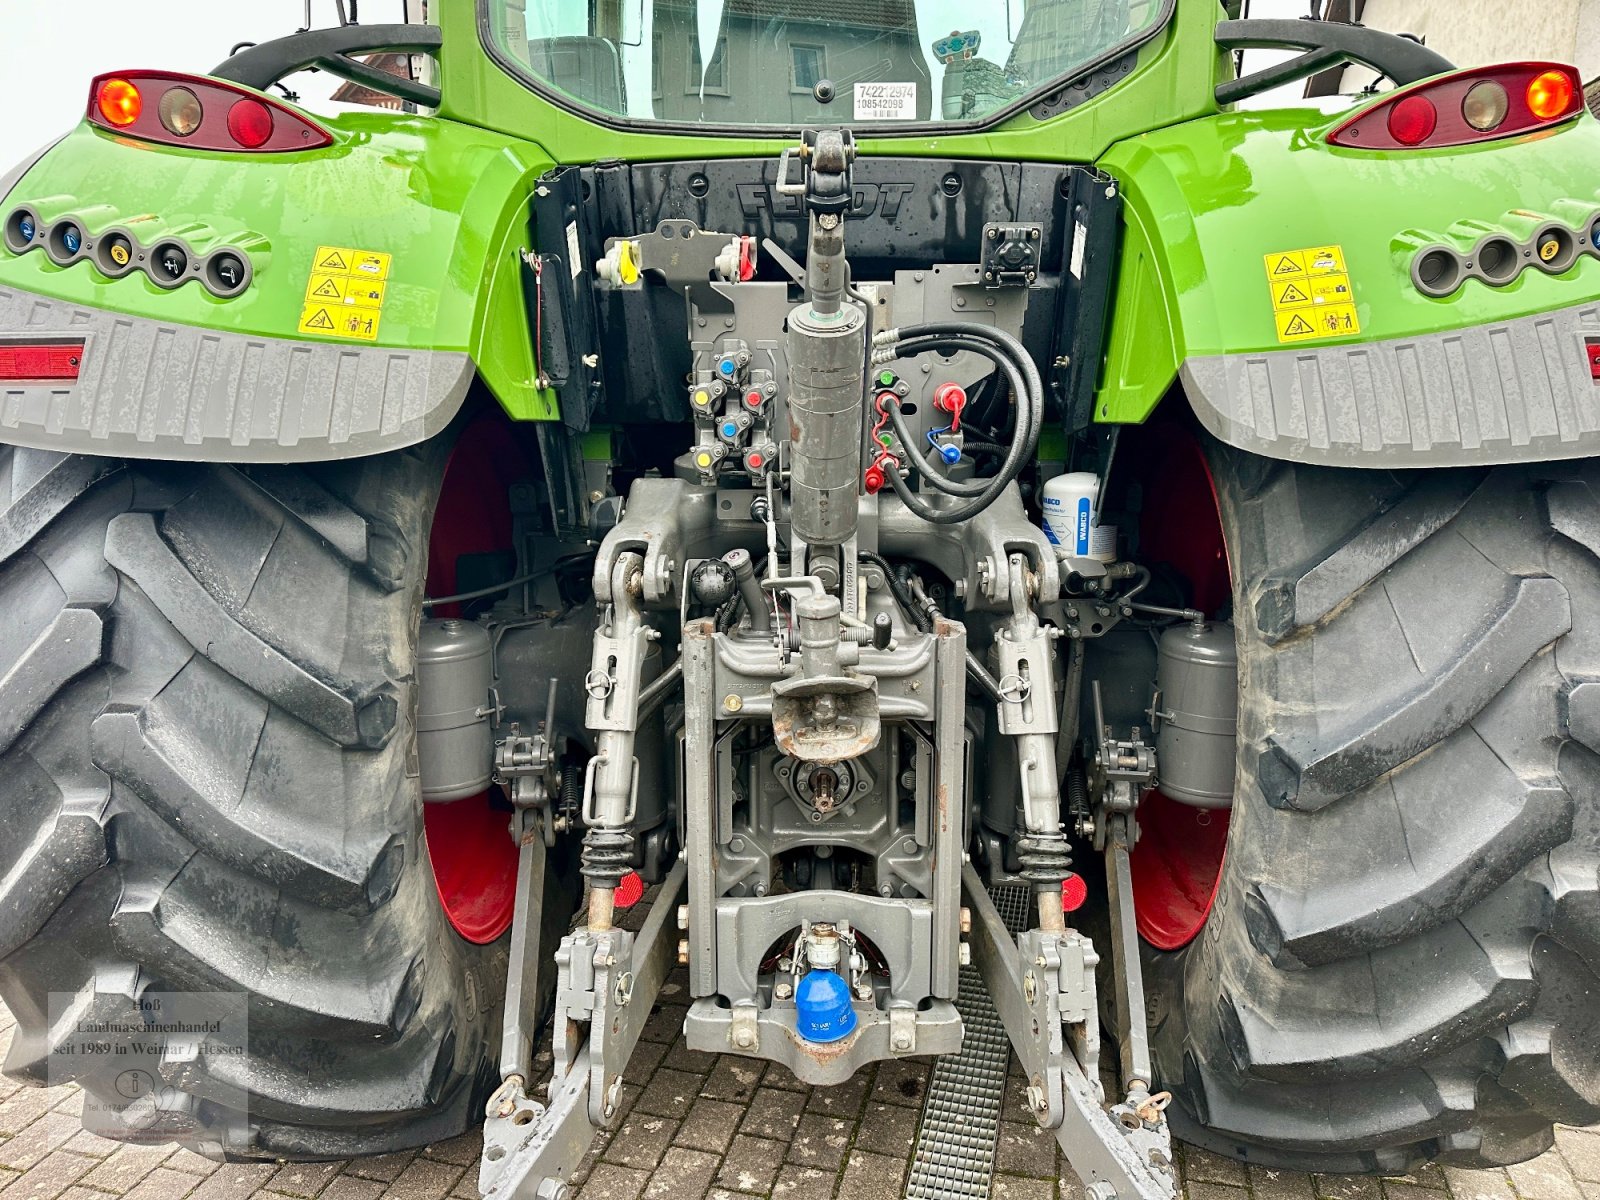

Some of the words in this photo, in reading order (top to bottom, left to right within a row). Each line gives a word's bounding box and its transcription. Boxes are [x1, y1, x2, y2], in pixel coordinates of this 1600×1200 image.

[860, 85, 914, 98] 742212974
[857, 99, 904, 109] 108542098
[735, 183, 915, 219] FEDT
[1079, 512, 1087, 541] WABCO
